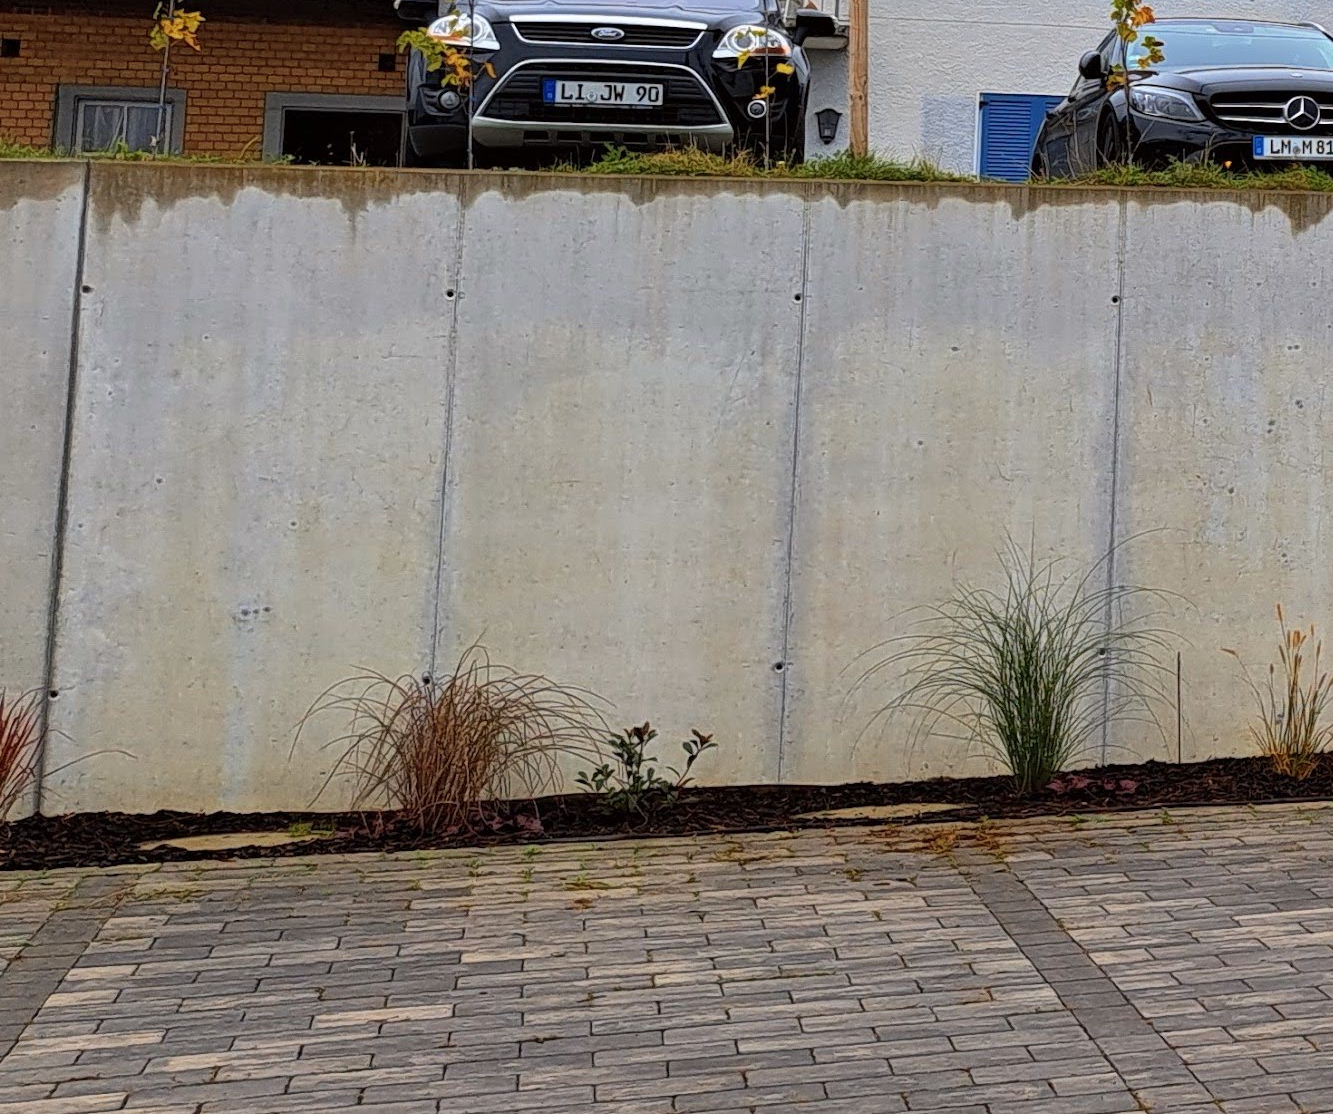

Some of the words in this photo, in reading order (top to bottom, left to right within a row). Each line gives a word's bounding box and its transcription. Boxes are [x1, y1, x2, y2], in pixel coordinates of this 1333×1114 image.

[561, 83, 585, 100] LI
[600, 85, 625, 101] JW
[636, 86, 660, 102] 90
[1270, 139, 1291, 155] LM
